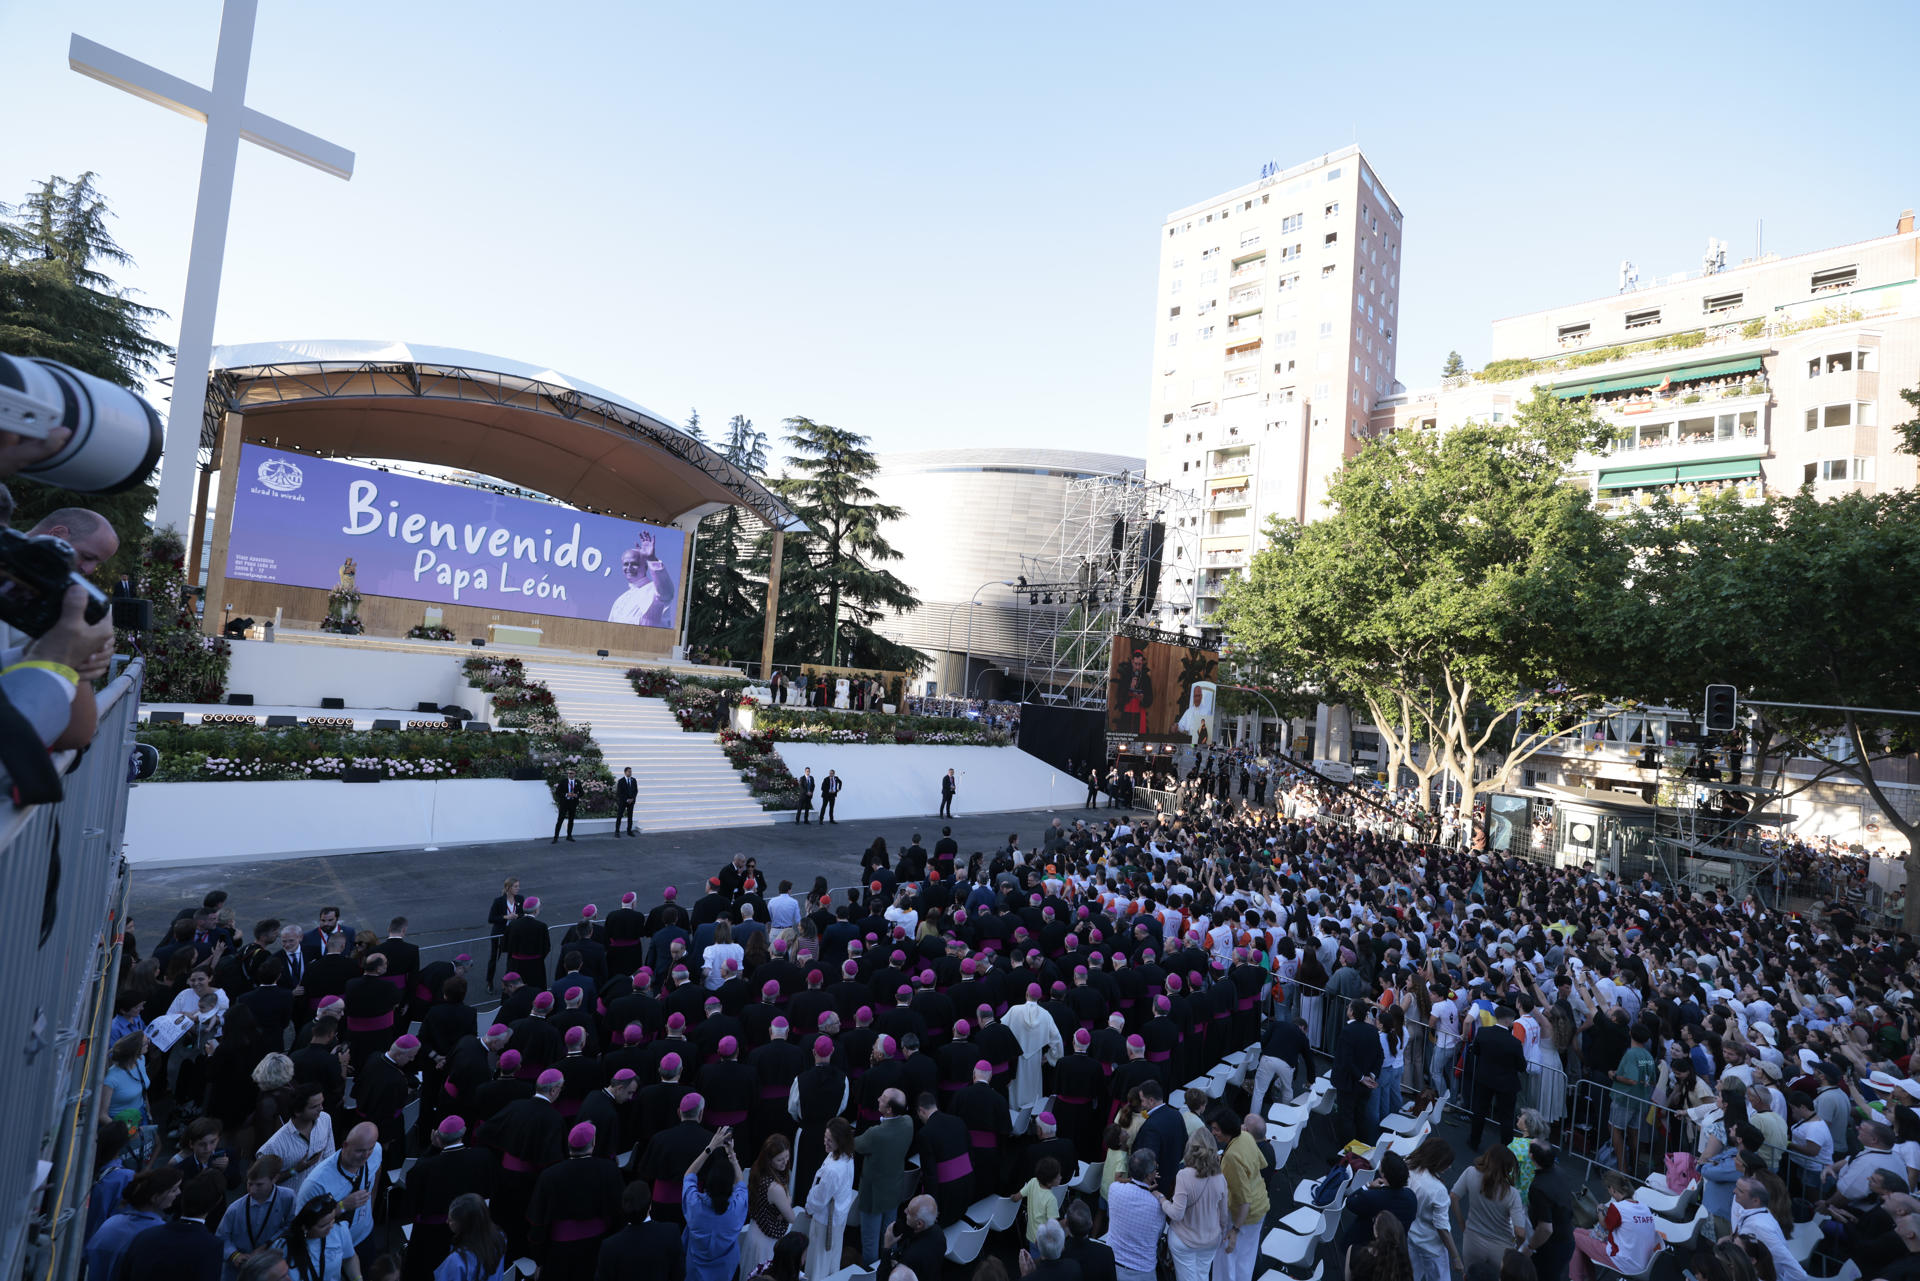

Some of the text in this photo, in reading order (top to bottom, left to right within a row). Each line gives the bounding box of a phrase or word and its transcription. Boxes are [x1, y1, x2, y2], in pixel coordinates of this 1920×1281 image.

[342, 480, 611, 577] Bienvenido,
[414, 549, 566, 601] Papa León
[1632, 1215, 1654, 1224] STAFF
